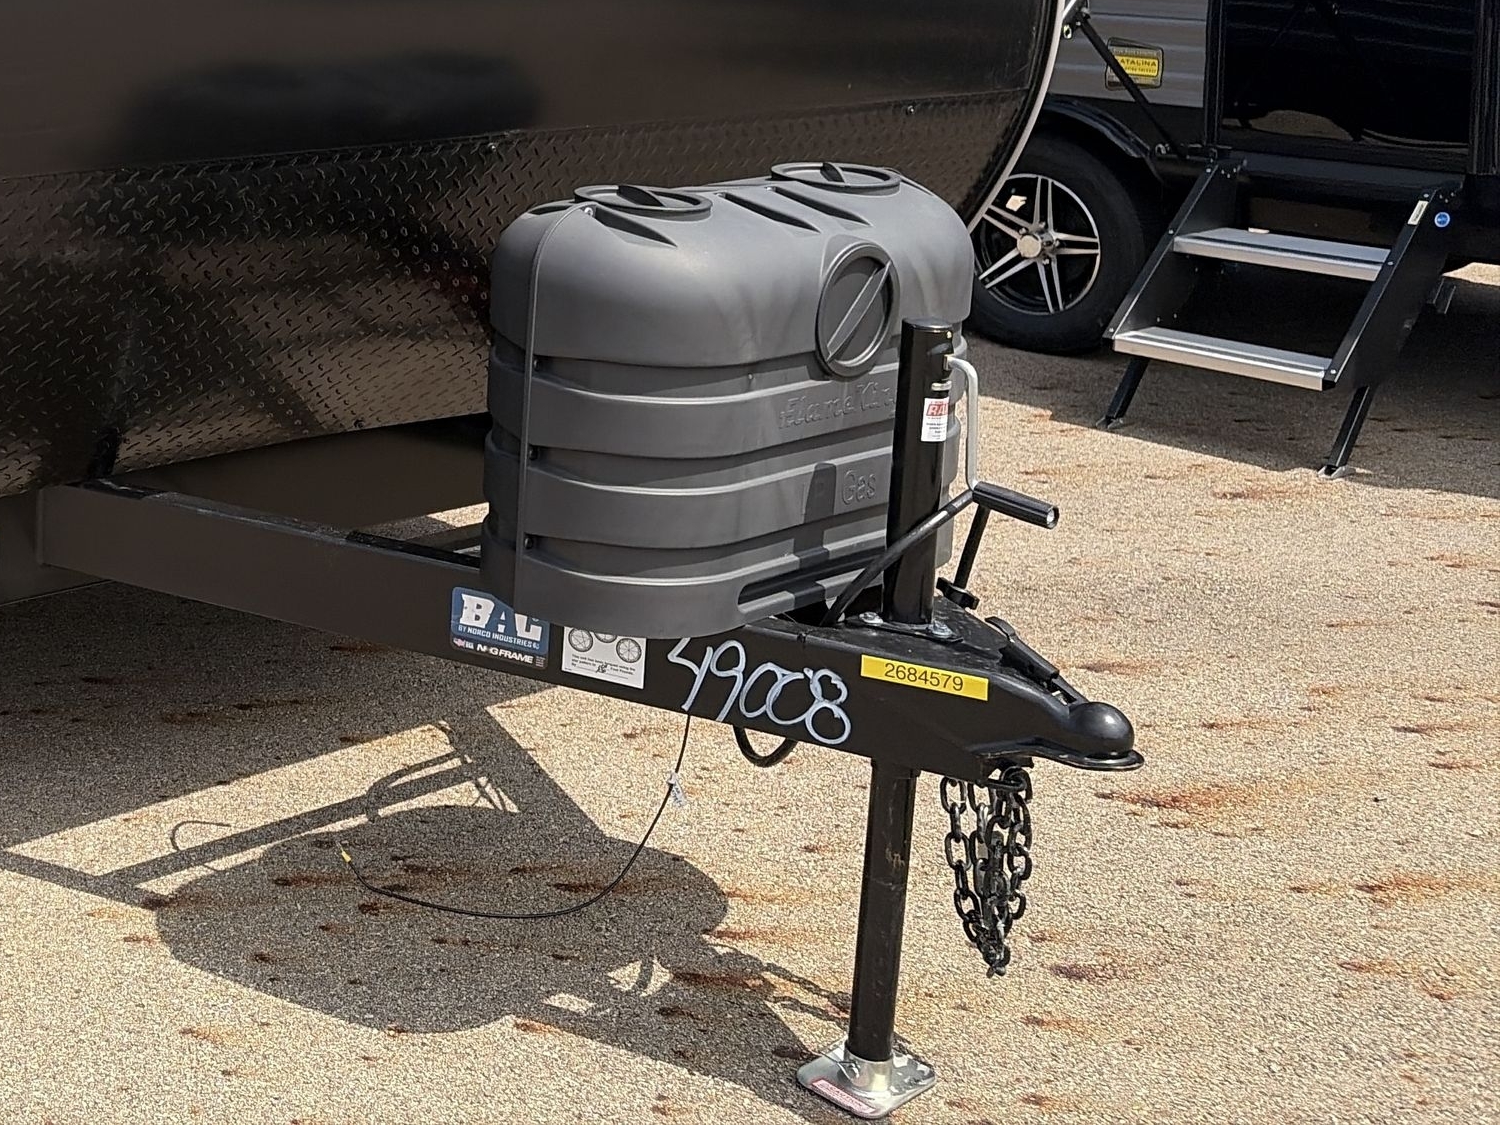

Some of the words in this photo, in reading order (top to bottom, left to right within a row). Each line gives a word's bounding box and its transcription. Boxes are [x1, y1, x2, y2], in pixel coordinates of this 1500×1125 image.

[1119, 58, 1157, 67] ATALINA
[459, 593, 542, 642] BAL
[467, 627, 491, 638] NORCO
[492, 632, 533, 648] INDUSTRIES
[499, 649, 534, 664] FRAME
[884, 662, 964, 692] 2684579
[667, 637, 852, 745] 49008
